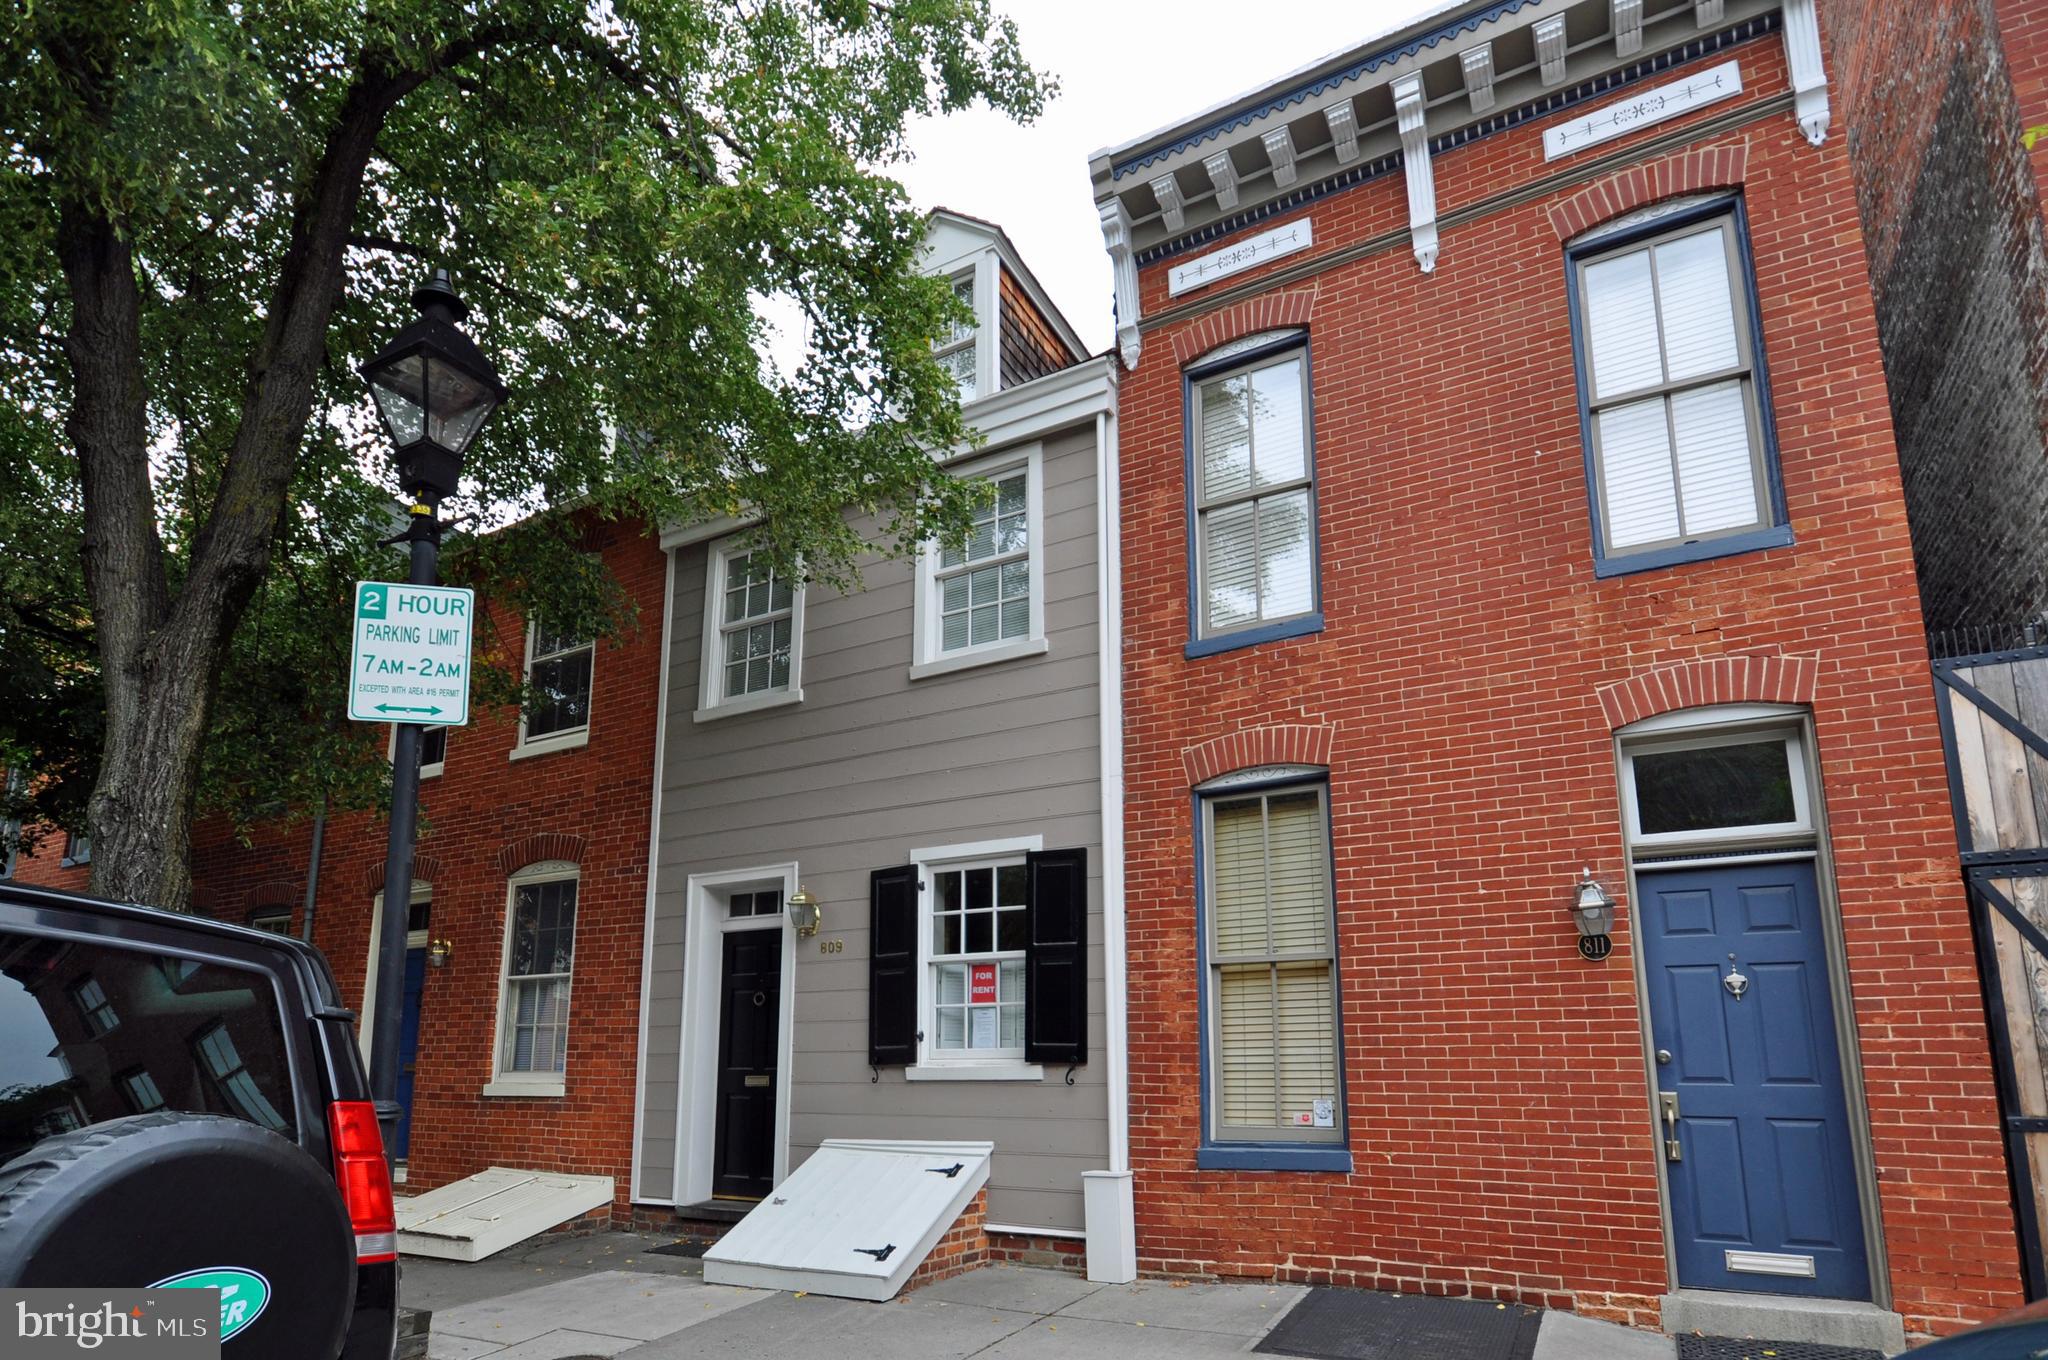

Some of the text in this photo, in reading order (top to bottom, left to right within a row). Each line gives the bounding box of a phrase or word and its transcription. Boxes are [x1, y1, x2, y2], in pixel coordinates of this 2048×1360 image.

[363, 591, 465, 616] 2 HOUR
[366, 623, 459, 646] PARKING LIMIT
[359, 684, 389, 693] EXCEPTED
[392, 685, 406, 694] WITH
[408, 687, 424, 696] AREA
[439, 688, 460, 698] PERMIT
[820, 940, 843, 954] 809
[1583, 937, 1606, 953] 811
[976, 972, 993, 980] FOR
[973, 986, 995, 994] RENT
